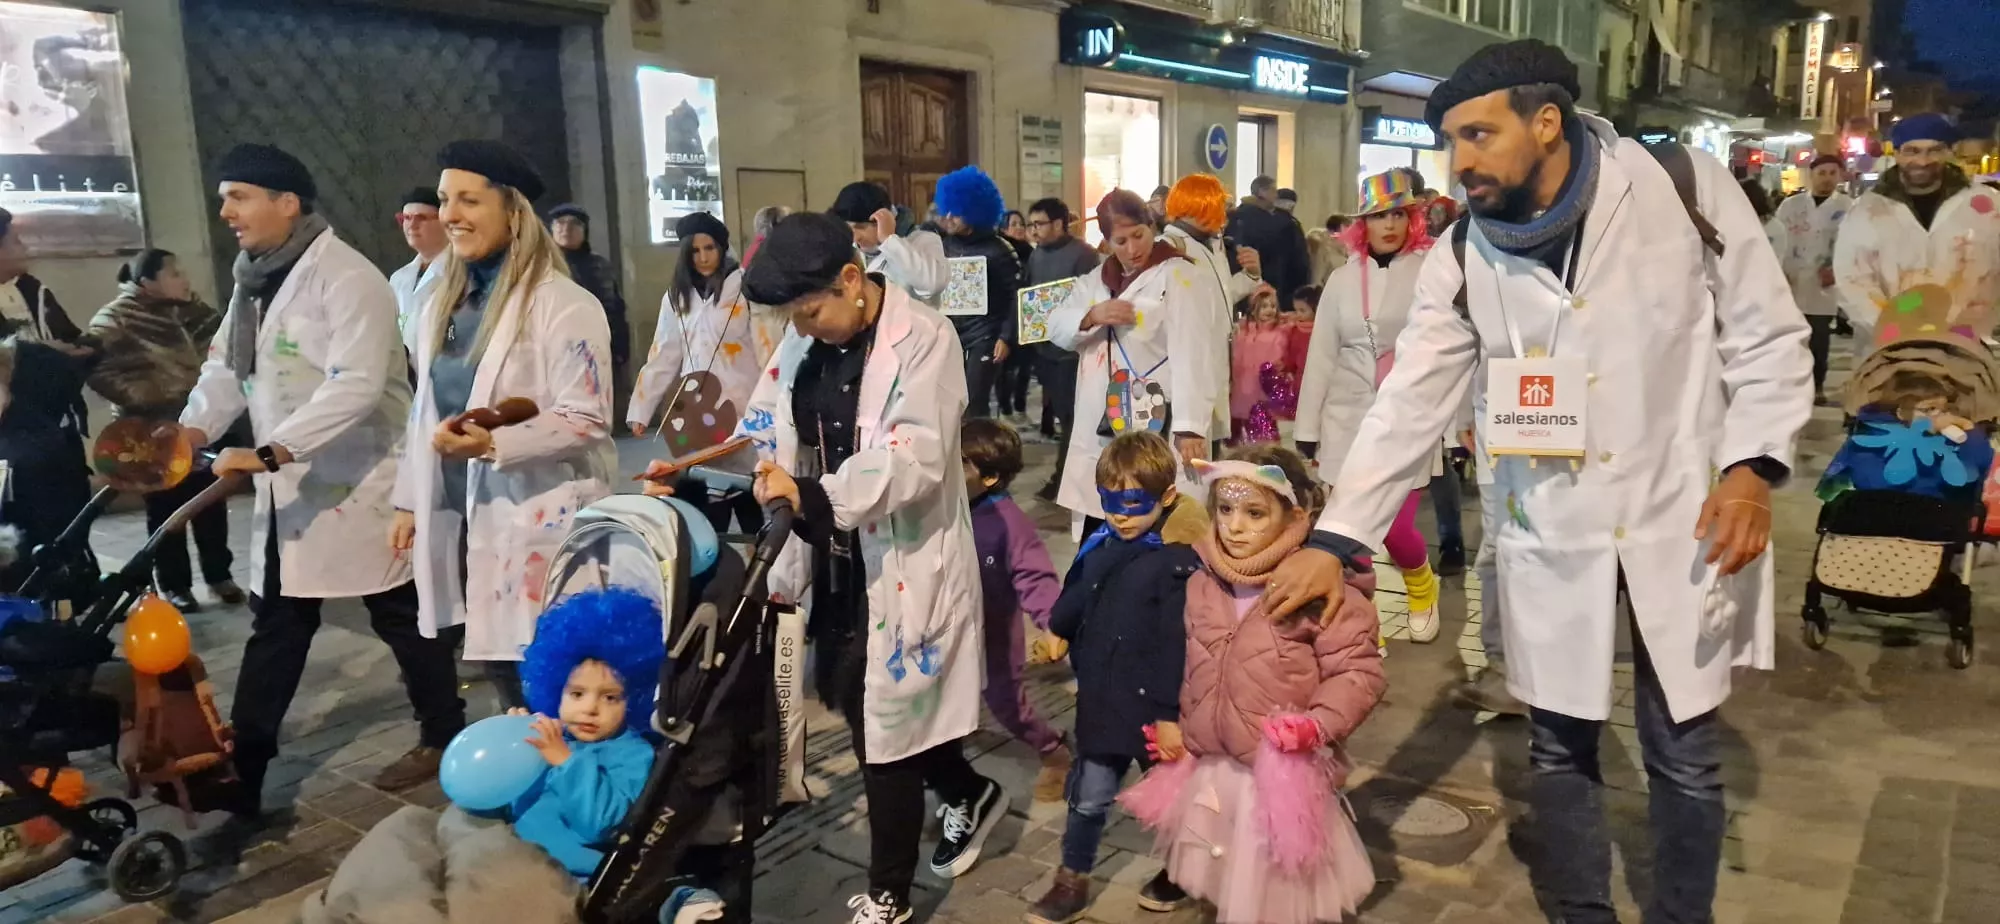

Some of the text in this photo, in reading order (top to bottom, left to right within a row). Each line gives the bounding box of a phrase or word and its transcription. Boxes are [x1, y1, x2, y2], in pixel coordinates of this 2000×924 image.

[1087, 27, 1114, 57] IN
[1256, 55, 1310, 94] INSIDE
[1804, 23, 1819, 117] FARMACIA
[664, 152, 706, 165] REBAJAS
[1493, 411, 1578, 426] salesianos
[1517, 430, 1552, 438] HUESCA
